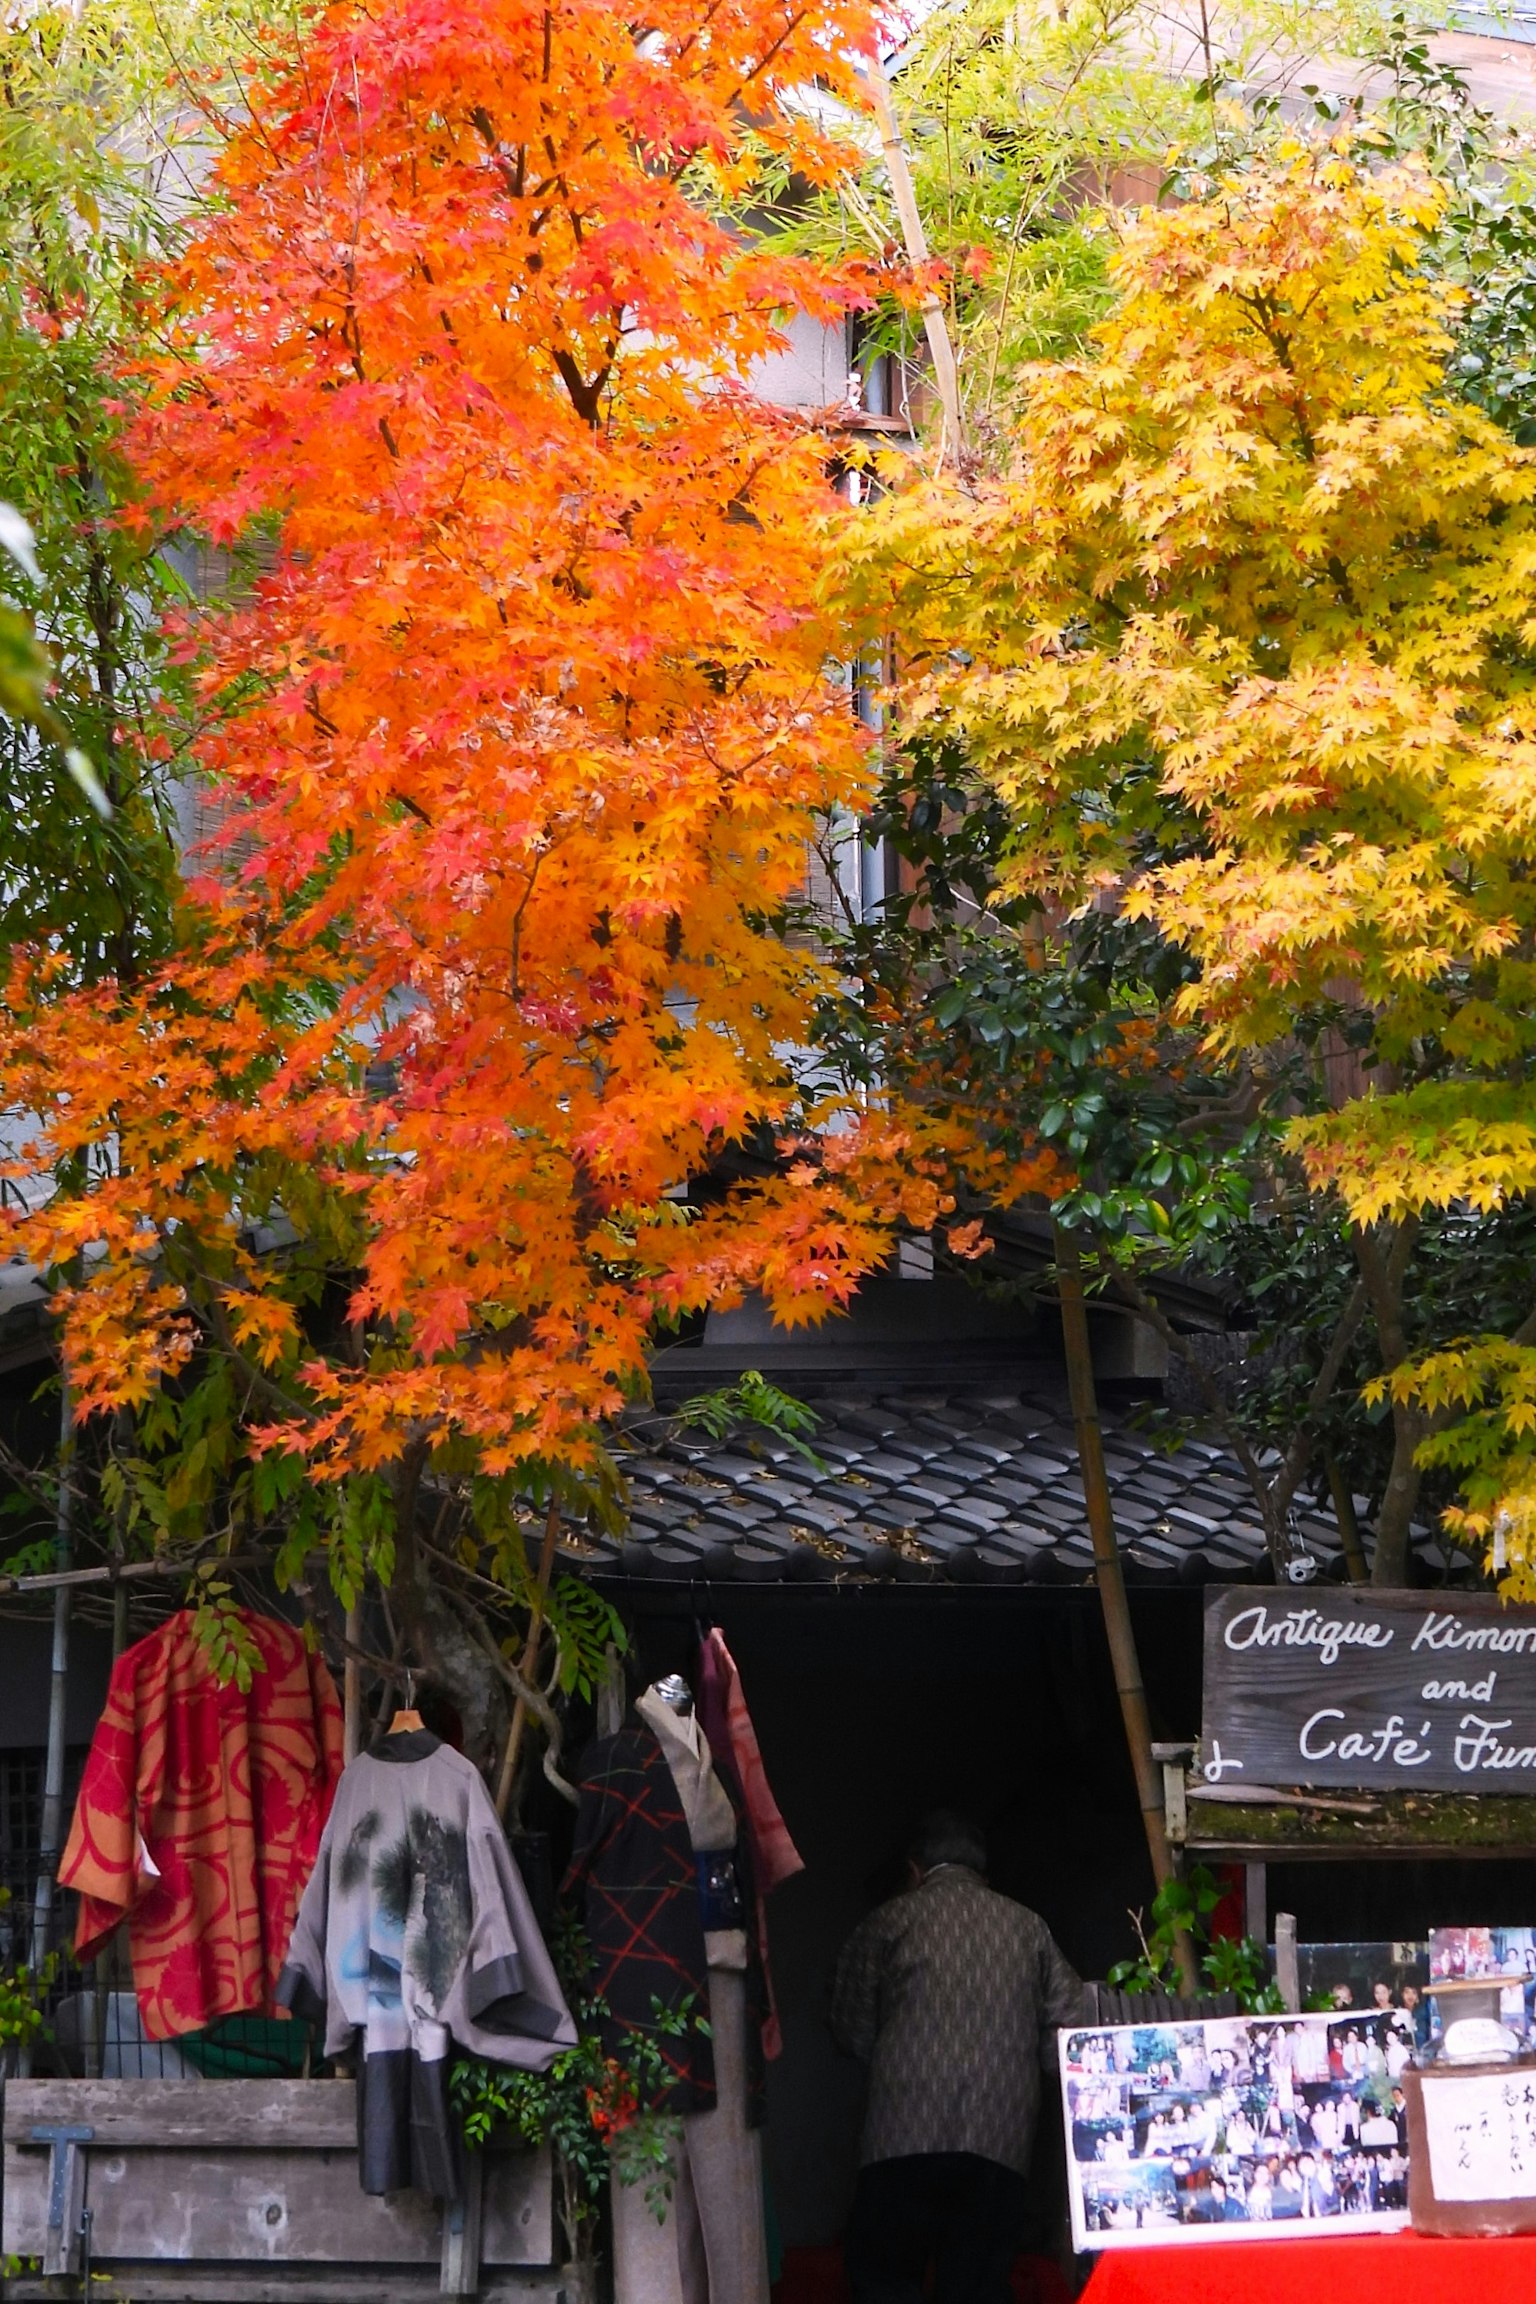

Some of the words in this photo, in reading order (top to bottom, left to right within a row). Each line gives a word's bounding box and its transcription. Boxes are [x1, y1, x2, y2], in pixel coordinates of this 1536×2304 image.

[1224, 1606, 1394, 1665] Antique
[1422, 1671, 1497, 1702] and
[1300, 1709, 1432, 1766] Café
